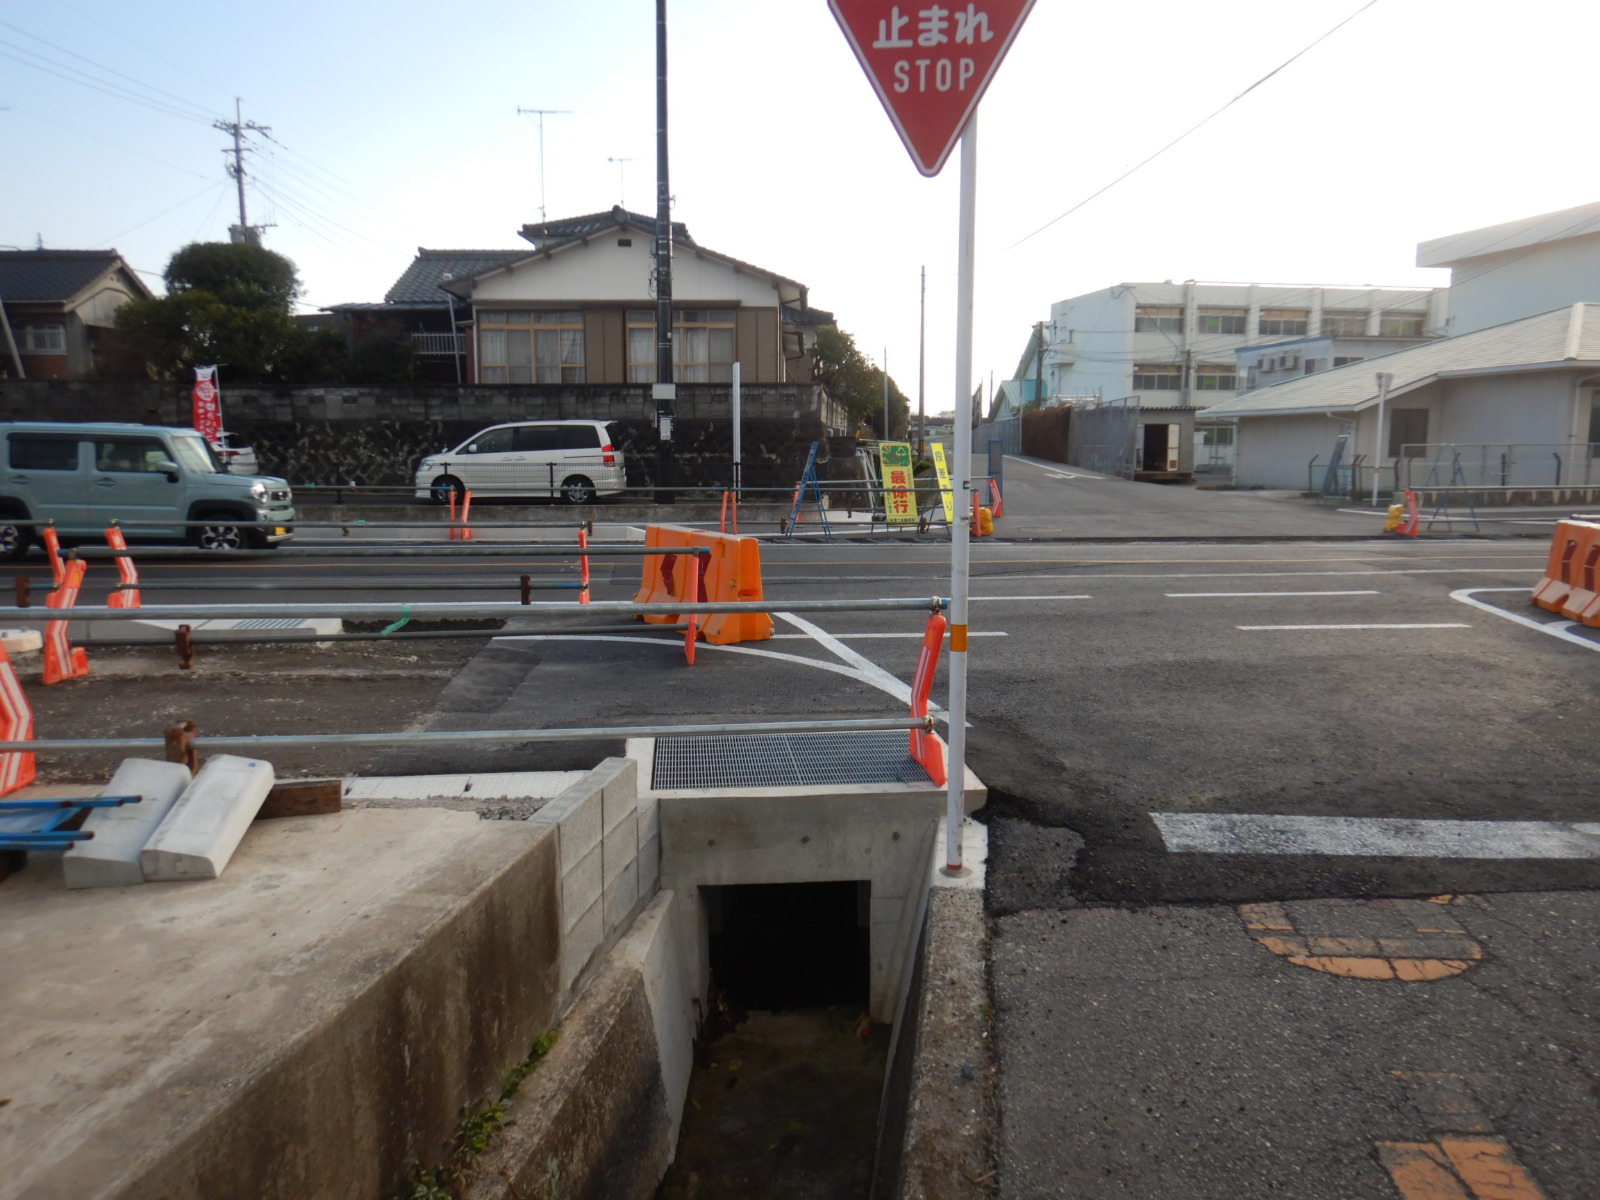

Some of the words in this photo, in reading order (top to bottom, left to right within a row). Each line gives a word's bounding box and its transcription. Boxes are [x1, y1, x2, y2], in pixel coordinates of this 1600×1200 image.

[872, 3, 994, 48] 止まれ
[894, 58, 975, 93] STOP
[890, 470, 909, 514] 最徐行
